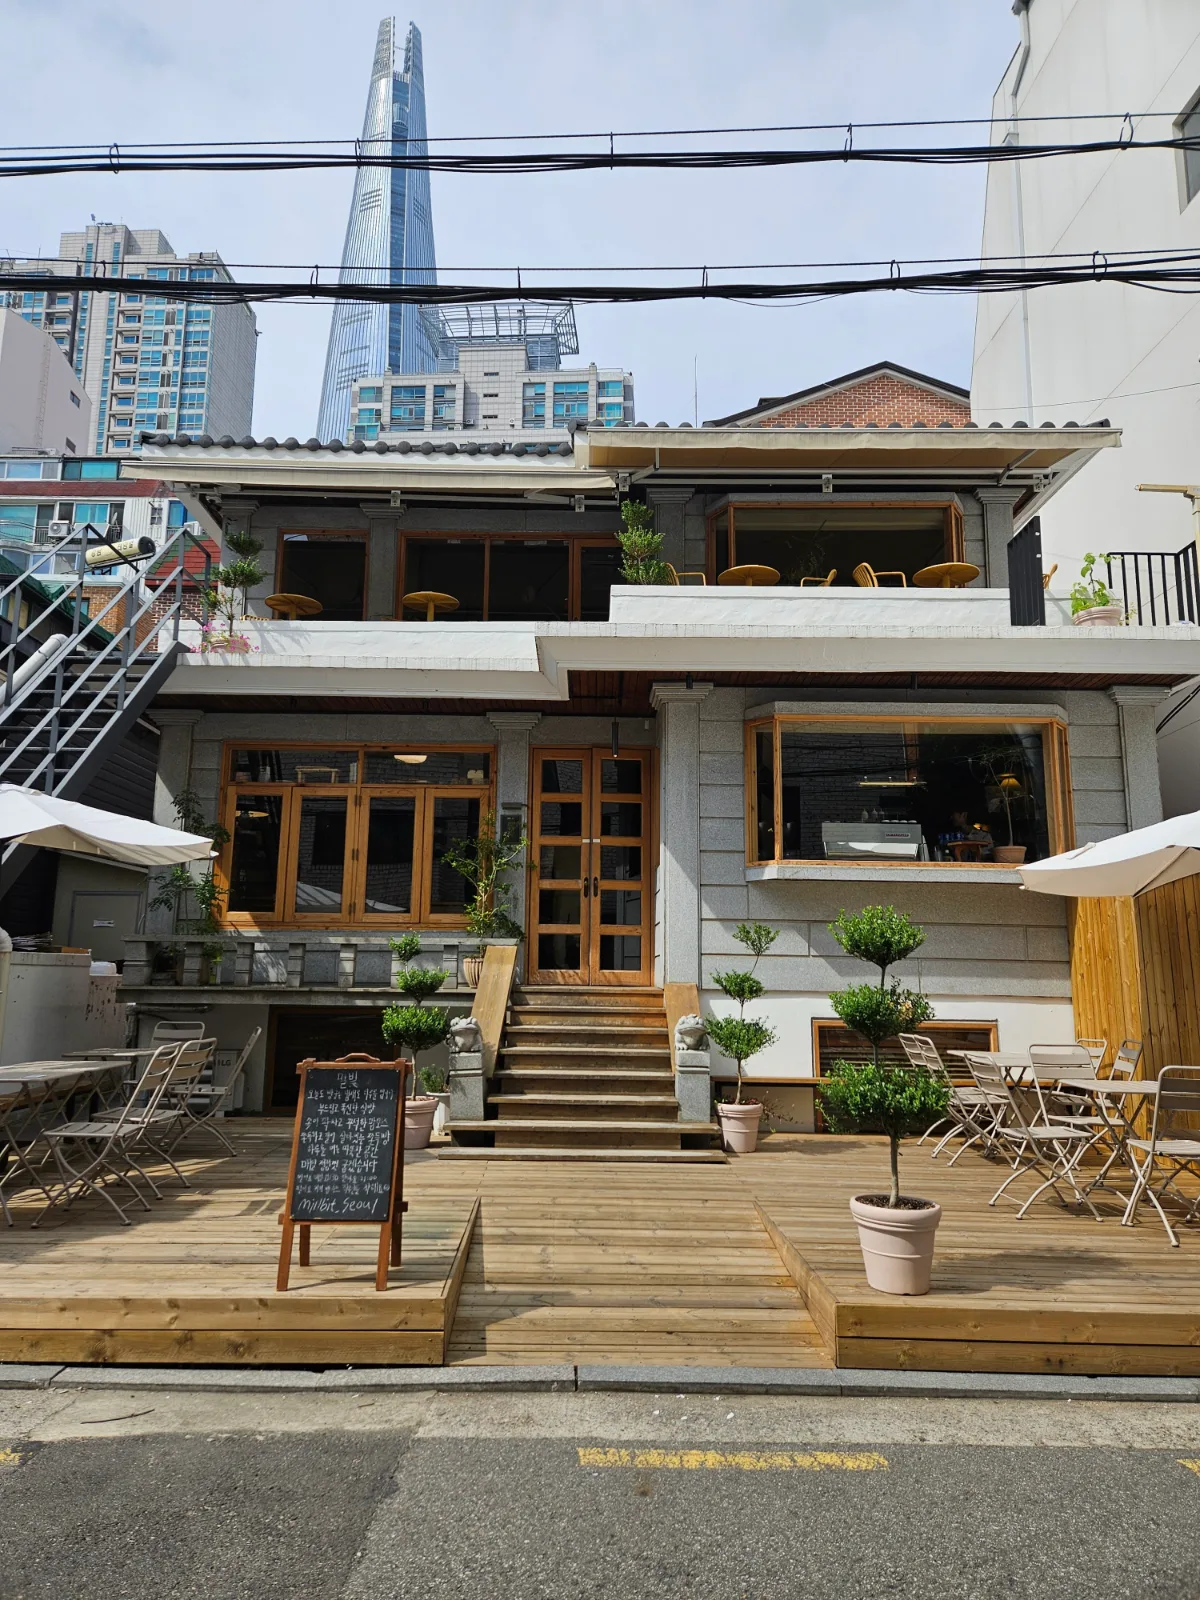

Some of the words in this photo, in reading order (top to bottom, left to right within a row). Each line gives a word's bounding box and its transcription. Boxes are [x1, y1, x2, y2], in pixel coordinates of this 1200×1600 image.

[221, 1059, 232, 1067] LG
[337, 1071, 358, 1089] 밀빛
[307, 1089, 324, 1100] 오늘도
[317, 1103, 340, 1115] 부드럽고
[360, 1102, 376, 1115] 식빵
[305, 1117, 319, 1130] 속이
[307, 1143, 327, 1157] 하루를
[342, 1144, 362, 1158] 따뜻한
[364, 1144, 379, 1158] 공간
[301, 1158, 317, 1171] 매일
[341, 1158, 378, 1173] 굽겠습니다
